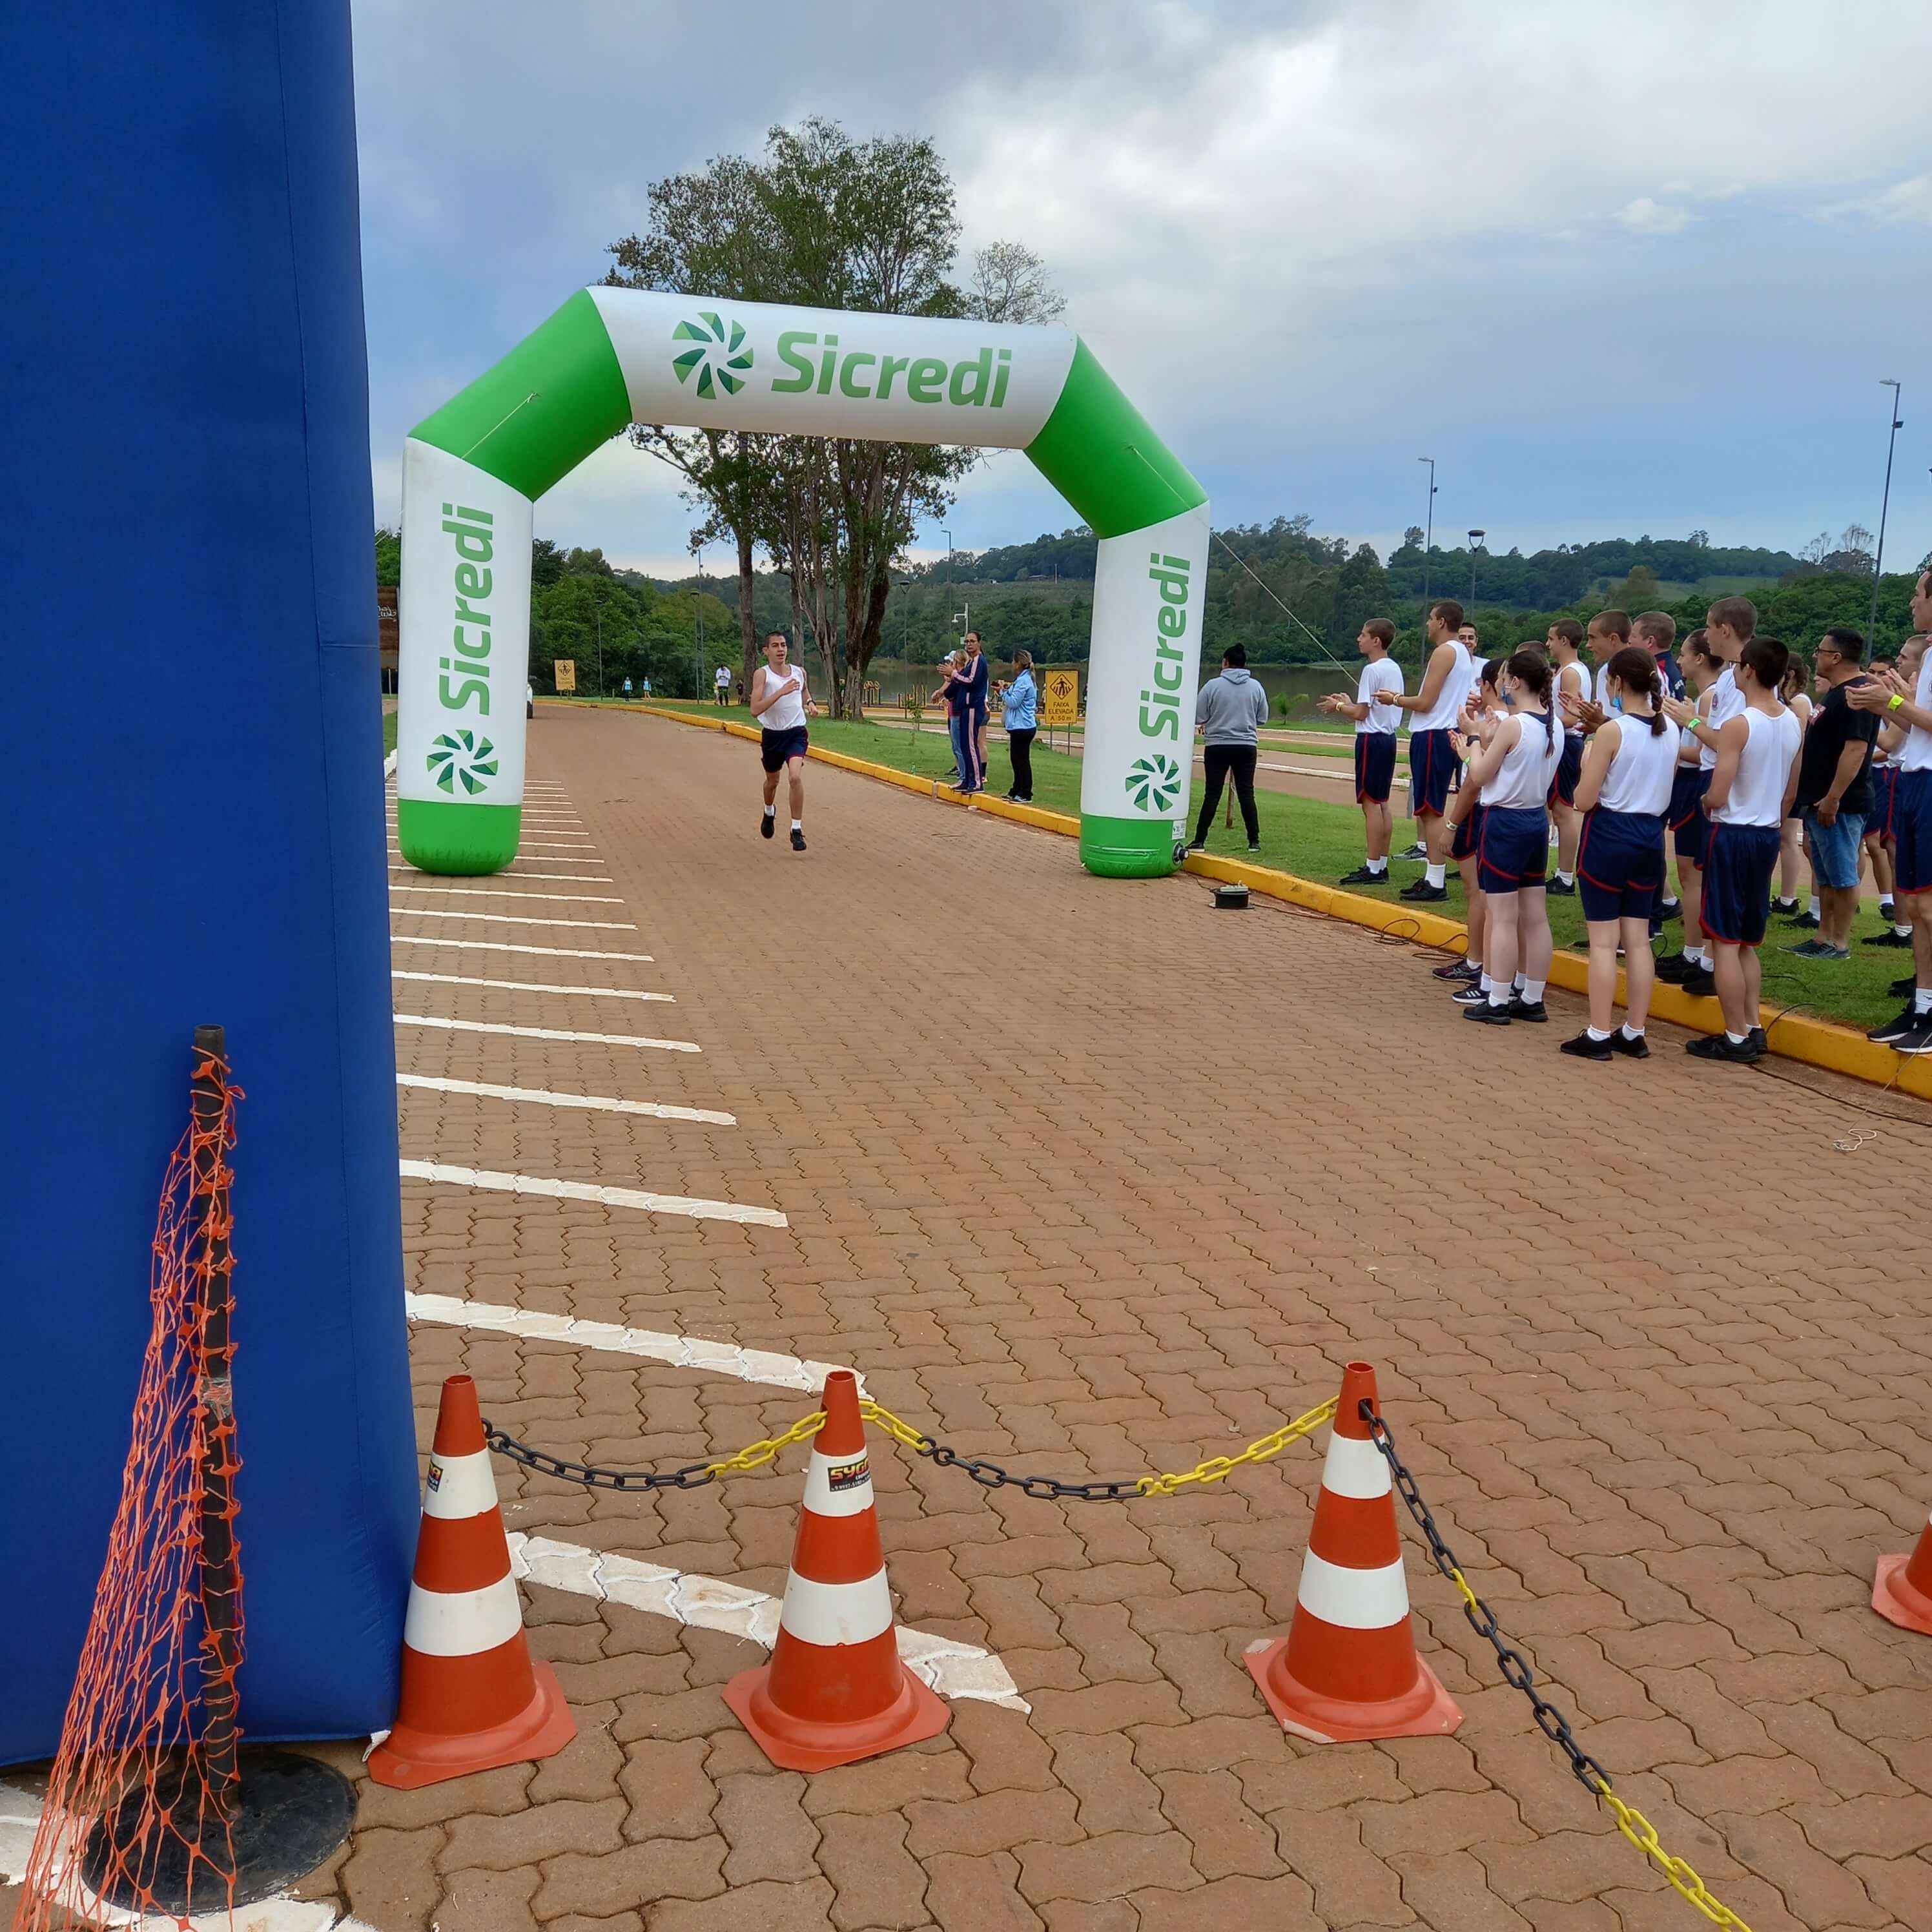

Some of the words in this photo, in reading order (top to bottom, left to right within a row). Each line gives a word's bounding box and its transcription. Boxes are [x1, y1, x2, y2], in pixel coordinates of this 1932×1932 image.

[771, 330, 1012, 408] Sicredi
[439, 502, 493, 716] Sicredi
[1138, 552, 1191, 741] Sicredi
